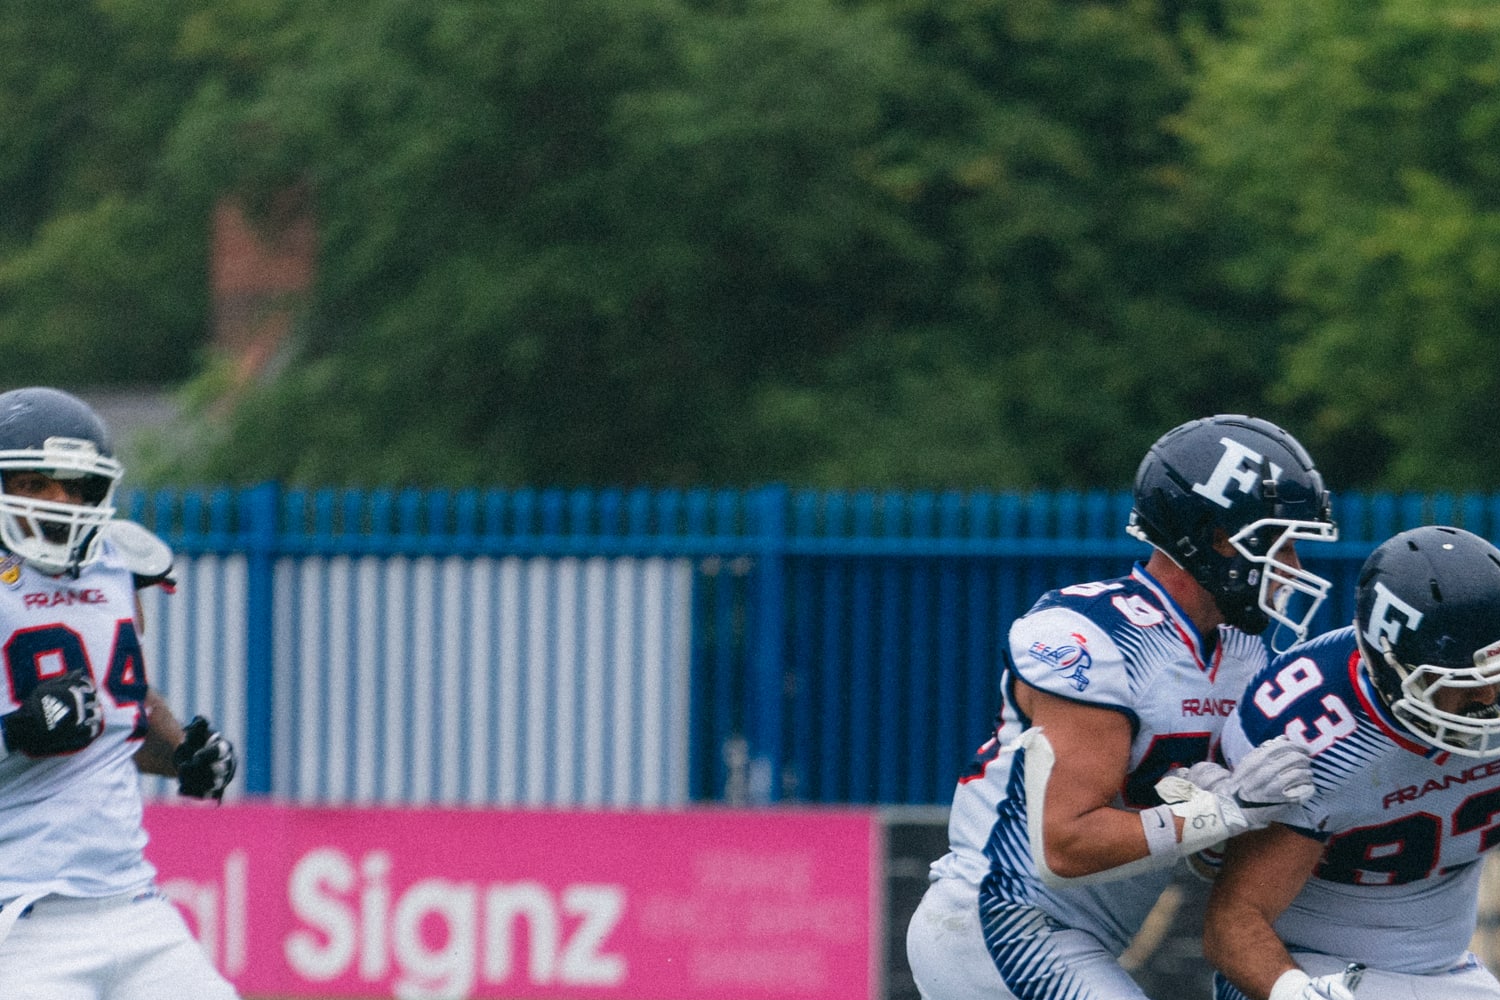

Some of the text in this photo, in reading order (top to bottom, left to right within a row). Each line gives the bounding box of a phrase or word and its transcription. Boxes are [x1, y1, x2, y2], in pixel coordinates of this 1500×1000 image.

[1192, 437, 1283, 509] F
[24, 589, 107, 609] FRANCE
[1363, 581, 1424, 654] F
[1182, 698, 1237, 717] FRANC
[1254, 657, 1358, 757] 93
